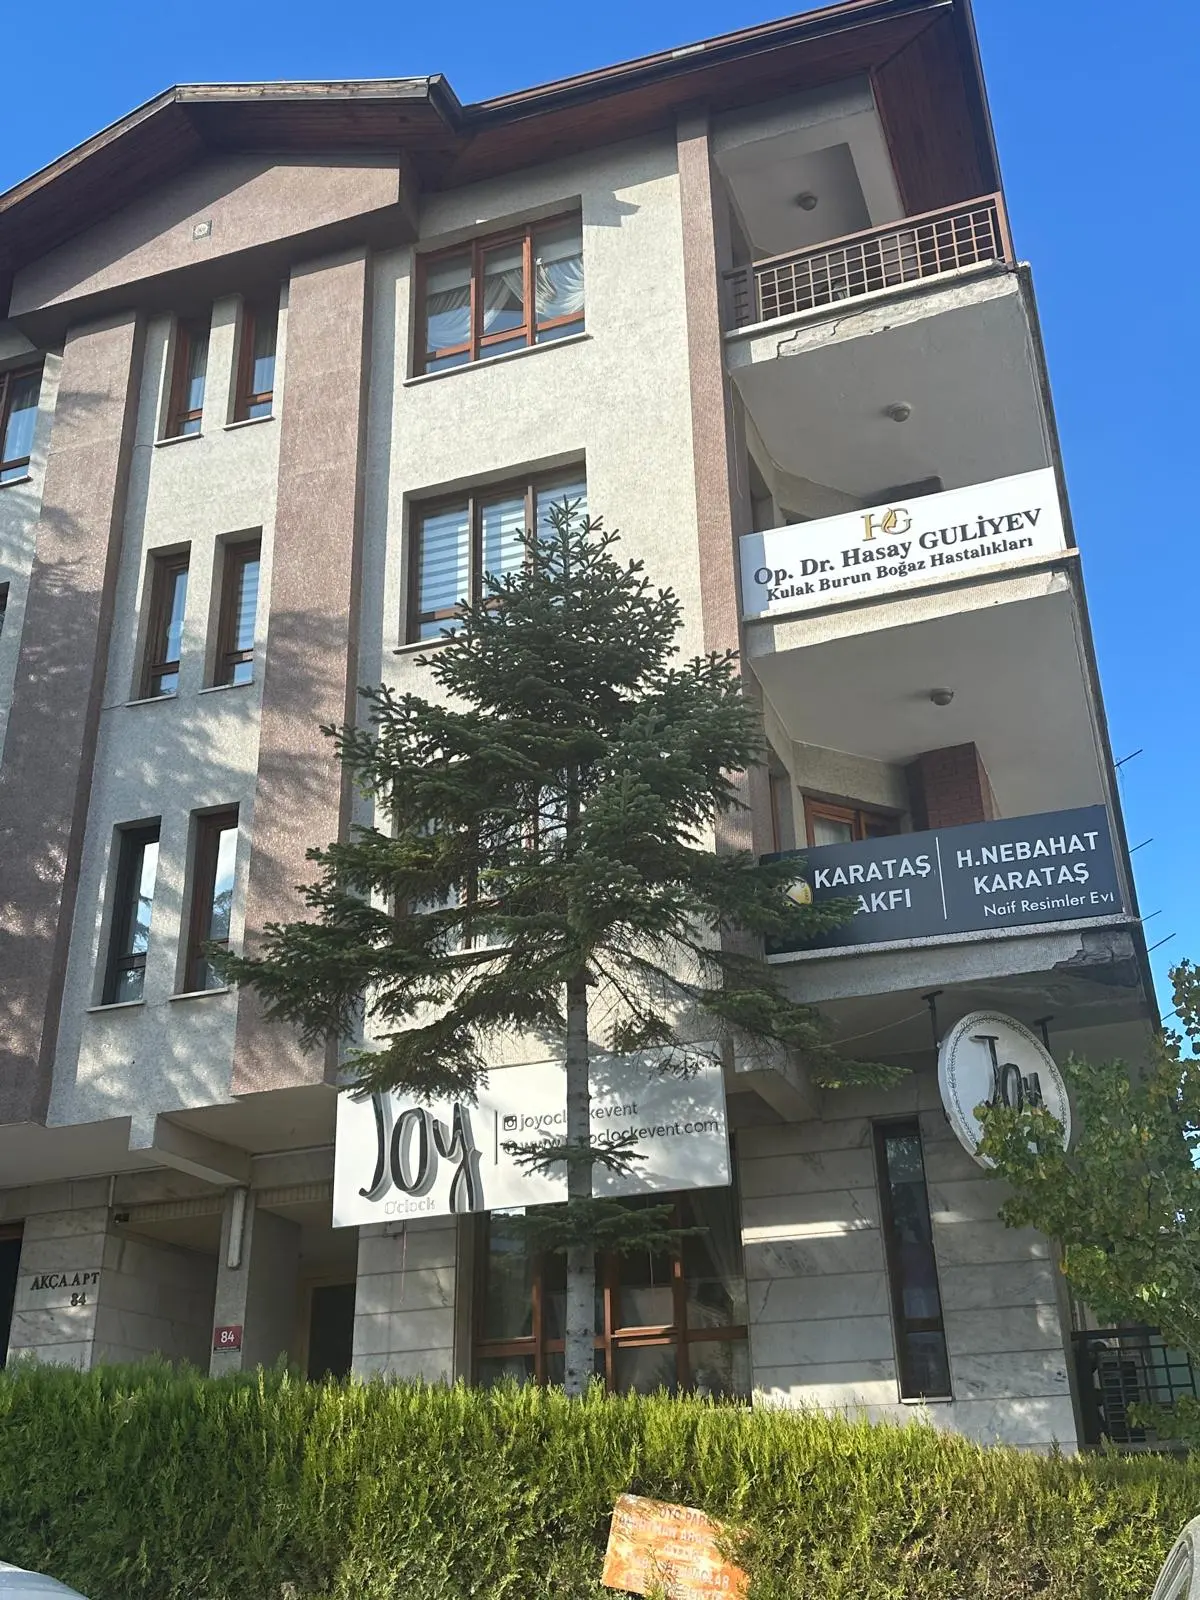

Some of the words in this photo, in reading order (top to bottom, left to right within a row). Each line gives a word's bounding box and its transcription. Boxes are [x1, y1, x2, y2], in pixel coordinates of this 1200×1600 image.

[753, 566, 794, 586] Op.
[800, 557, 835, 577] Dr.
[841, 539, 913, 568] Hasay
[918, 507, 1042, 550] GULİYEV
[766, 581, 815, 602] Kulak
[818, 572, 872, 592] Burun
[876, 560, 926, 579] Boğaz
[930, 537, 1034, 567] Hastalıkları
[956, 831, 1099, 869] H.NEBAHAT
[813, 854, 932, 889] KARATAŞ
[973, 862, 1090, 895] KARATAŞ
[852, 887, 912, 915] AKFI
[984, 902, 1017, 917] Naif
[1020, 894, 1087, 913] Resimler
[519, 1102, 638, 1131] joyoclkevent
[347, 1092, 483, 1213] Joy
[70, 1291, 87, 1307] 84
[220, 1330, 235, 1343] 84
